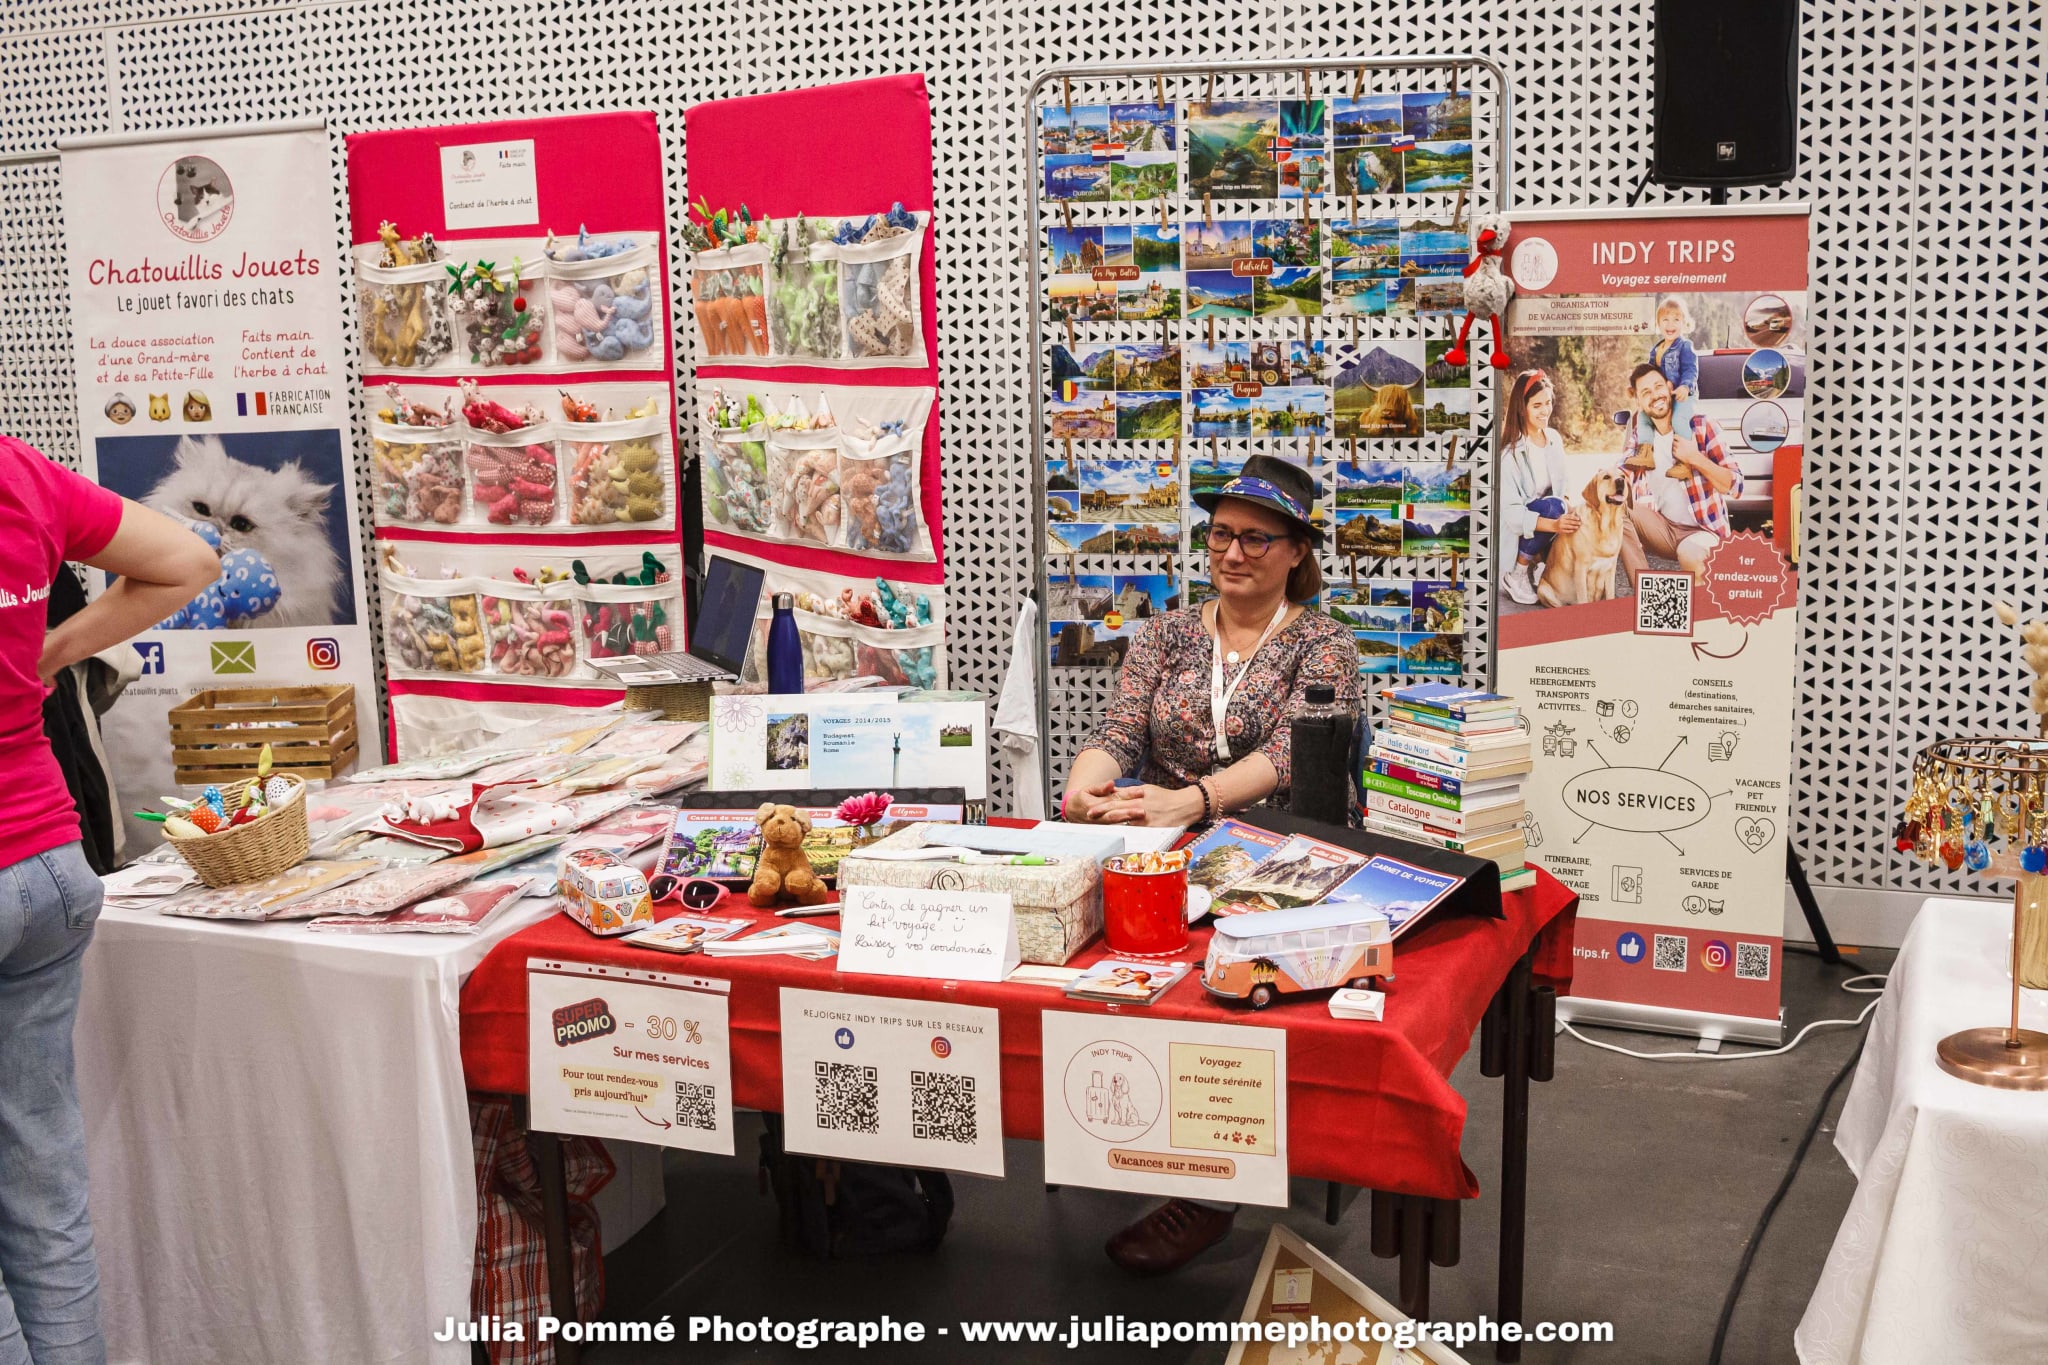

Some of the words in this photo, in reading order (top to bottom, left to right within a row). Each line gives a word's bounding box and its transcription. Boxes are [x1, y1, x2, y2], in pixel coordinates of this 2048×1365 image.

[449, 201, 475, 210] Contient
[1592, 241, 1655, 265] INDY
[1667, 239, 1736, 264] TRIPS
[88, 254, 223, 286] Chatouillis
[232, 248, 320, 279] Jouets
[1601, 273, 1650, 287] Voyagez
[1653, 272, 1727, 285] sereinement
[117, 295, 133, 312] Le
[136, 292, 172, 315] jouet
[176, 289, 219, 309] favori
[223, 289, 247, 308] des
[251, 287, 295, 306] chats
[1550, 301, 1609, 309] ORGANISATION
[1528, 313, 1539, 321] DE
[1540, 313, 1582, 321] VACANCES
[1600, 312, 1633, 320] MESURE
[90, 337, 106, 349] La
[111, 334, 147, 349] douce
[150, 333, 215, 347] association
[241, 329, 272, 343] Faits
[98, 354, 133, 366] d'une
[137, 351, 210, 365] Grand-mère
[241, 346, 295, 361] Contient
[300, 344, 316, 358] de
[96, 373, 109, 383] et
[114, 370, 130, 383] de
[134, 372, 147, 382] sa
[152, 366, 214, 381] Petite-Fille
[233, 366, 278, 379] l'herbe
[282, 364, 290, 377] à
[269, 389, 331, 402] FABRICATION
[270, 404, 323, 416] FRANÇAISE
[1738, 556, 1755, 566] 1er
[1713, 571, 1778, 584] rendez-vous
[1728, 588, 1763, 600] gratuit
[1535, 665, 1591, 676] RECHERCHES:
[1529, 677, 1597, 688] HEBERGEMENTS
[1692, 678, 1733, 688] CONSEILS
[1535, 690, 1590, 700] TRANSPORTS
[1684, 690, 1738, 702] (destinations,
[1537, 702, 1587, 712] ACTIVITES...
[1669, 701, 1712, 712] démarches
[1713, 704, 1755, 715] sanitaires,
[1403, 742, 1413, 751] du
[1413, 744, 1430, 756] Nord
[1436, 764, 1453, 776] Europe
[1416, 771, 1438, 784] Budapest
[1735, 778, 1781, 789] VACANCES
[1405, 785, 1431, 800] Toscane
[1432, 792, 1457, 806] Ombrie
[1576, 788, 1611, 805] NOS
[1618, 791, 1696, 812] SERVICES
[1747, 791, 1764, 800] PET
[1388, 799, 1430, 820] Catalogne
[1735, 803, 1777, 813] FRIENDLY
[690, 814, 721, 822] Carnet
[722, 814, 734, 822] de
[1544, 855, 1592, 867] ITINERAIRE,
[1371, 861, 1400, 876] CARNET
[1401, 870, 1412, 879] DE
[1413, 874, 1448, 889] VOYAGE
[1551, 867, 1584, 877] CARNET
[1679, 867, 1719, 878] SERVICES
[1721, 869, 1732, 879] DE
[1691, 880, 1719, 890] GARDE
[900, 899, 915, 912] de
[920, 902, 963, 921] gagner
[968, 903, 988, 913] un
[868, 913, 887, 928] kit
[854, 934, 896, 959] Laissez
[905, 941, 924, 951] vos
[554, 1001, 602, 1026] SUPER
[556, 1013, 611, 1042] PROMO
[803, 1008, 851, 1022] REJOIGNEZ
[854, 1012, 876, 1024] INDY
[879, 1015, 903, 1026] TRIPS
[906, 1018, 924, 1028] SUR
[927, 1020, 943, 1030] LES
[945, 1022, 984, 1035] RESEAUX
[646, 1015, 677, 1041] 30
[683, 1019, 703, 1045] %
[613, 1046, 633, 1059] Sur
[635, 1050, 660, 1063] mes
[662, 1054, 710, 1070] services
[1091, 1048, 1110, 1058] INDY
[1111, 1048, 1133, 1062] TRIPS
[1199, 1056, 1242, 1069] Voyagez
[563, 1068, 585, 1080] Pour
[587, 1070, 604, 1081] tout
[606, 1073, 659, 1089] rendez-vous
[1179, 1074, 1191, 1083] en
[1193, 1074, 1221, 1085] toute
[1222, 1075, 1262, 1089] sérénité
[573, 1086, 592, 1098] pris
[1208, 1095, 1233, 1104] avec
[1177, 1110, 1204, 1121] votre
[1205, 1113, 1265, 1126] compagnon
[1213, 1130, 1221, 1140] à
[1222, 1132, 1229, 1142] 4
[1113, 1153, 1164, 1169] Vacances
[1166, 1160, 1186, 1171] sur
[1188, 1161, 1230, 1175] mesure
